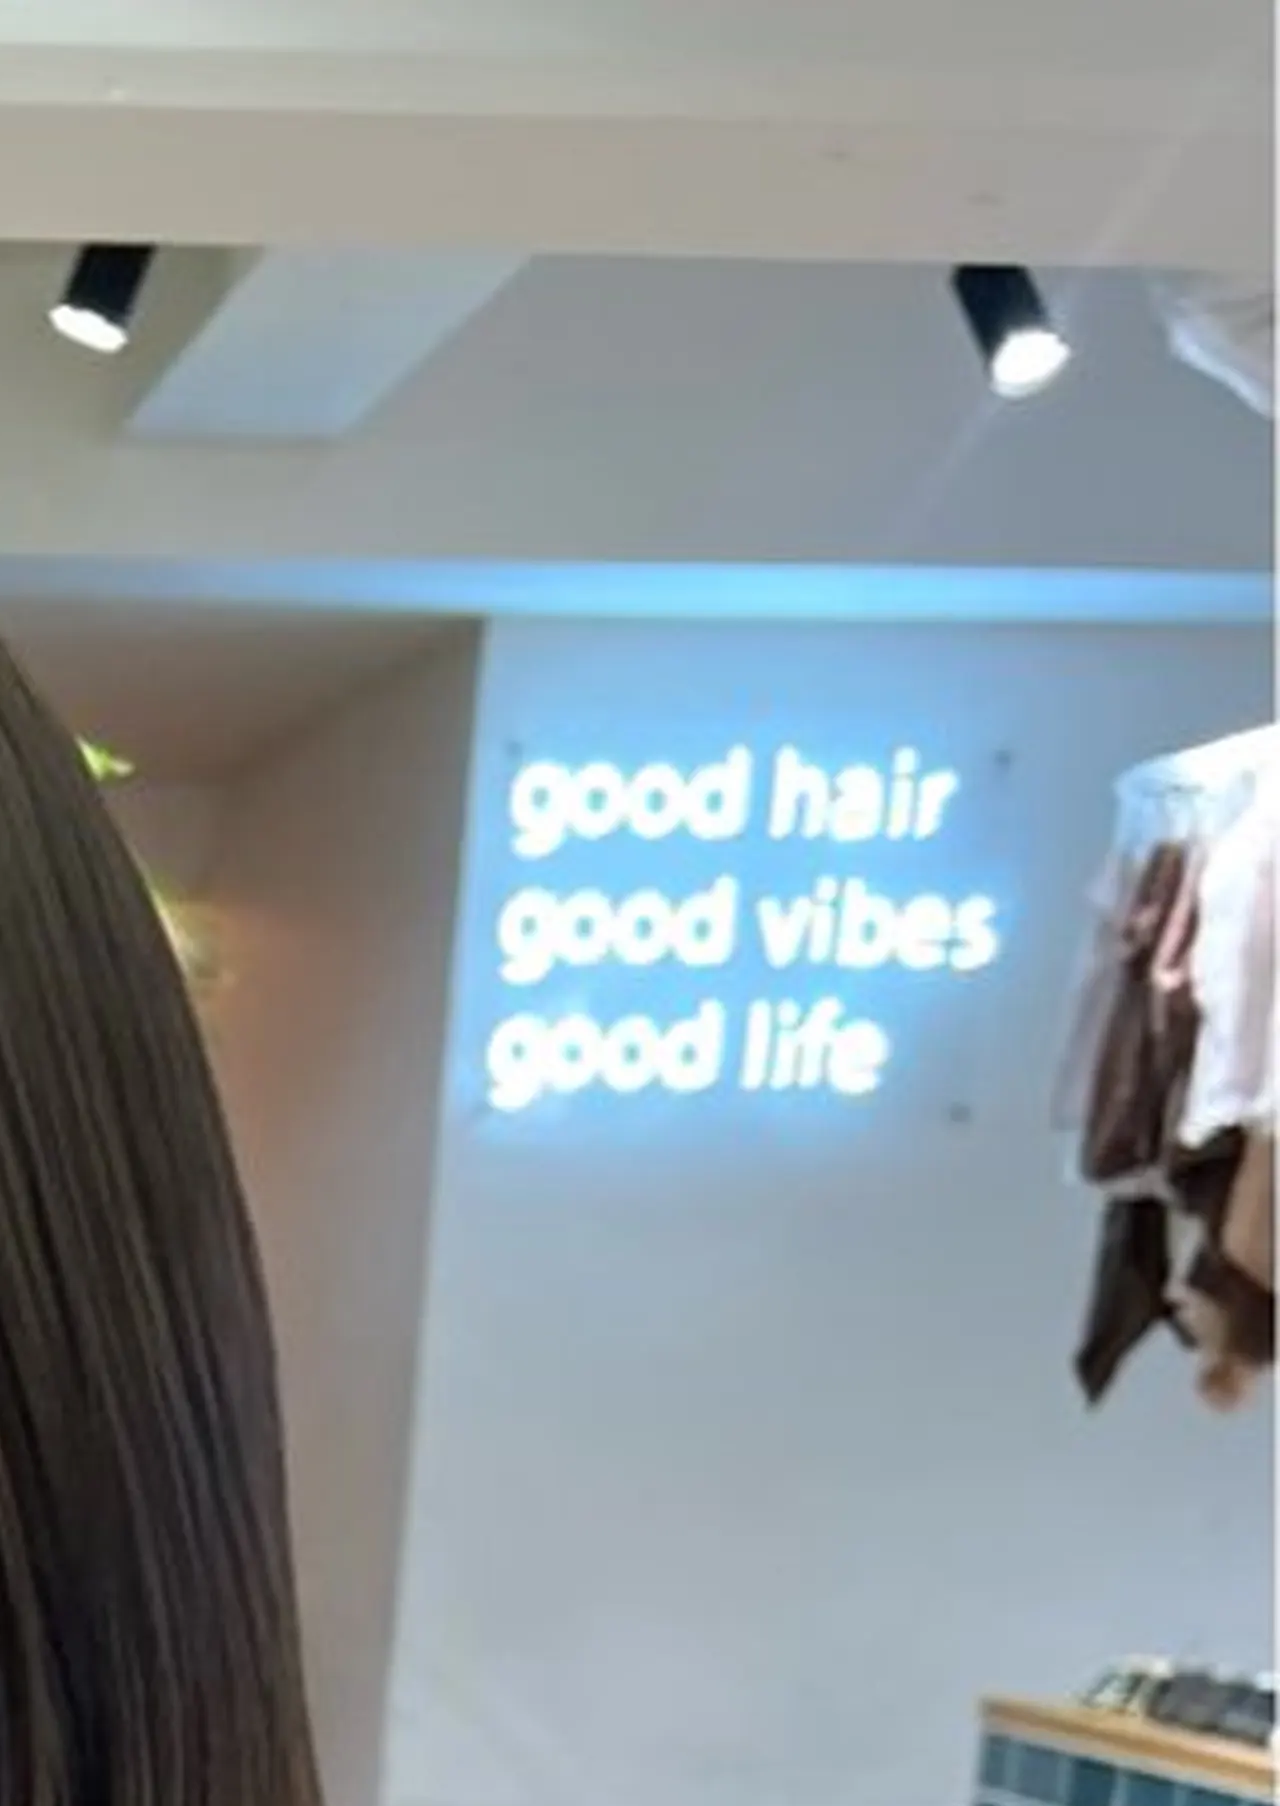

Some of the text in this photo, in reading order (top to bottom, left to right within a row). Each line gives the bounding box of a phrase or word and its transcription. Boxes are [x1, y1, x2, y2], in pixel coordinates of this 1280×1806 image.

[508, 743, 960, 858] good hair
[496, 874, 1000, 986] good vibes
[486, 998, 890, 1111] good life
